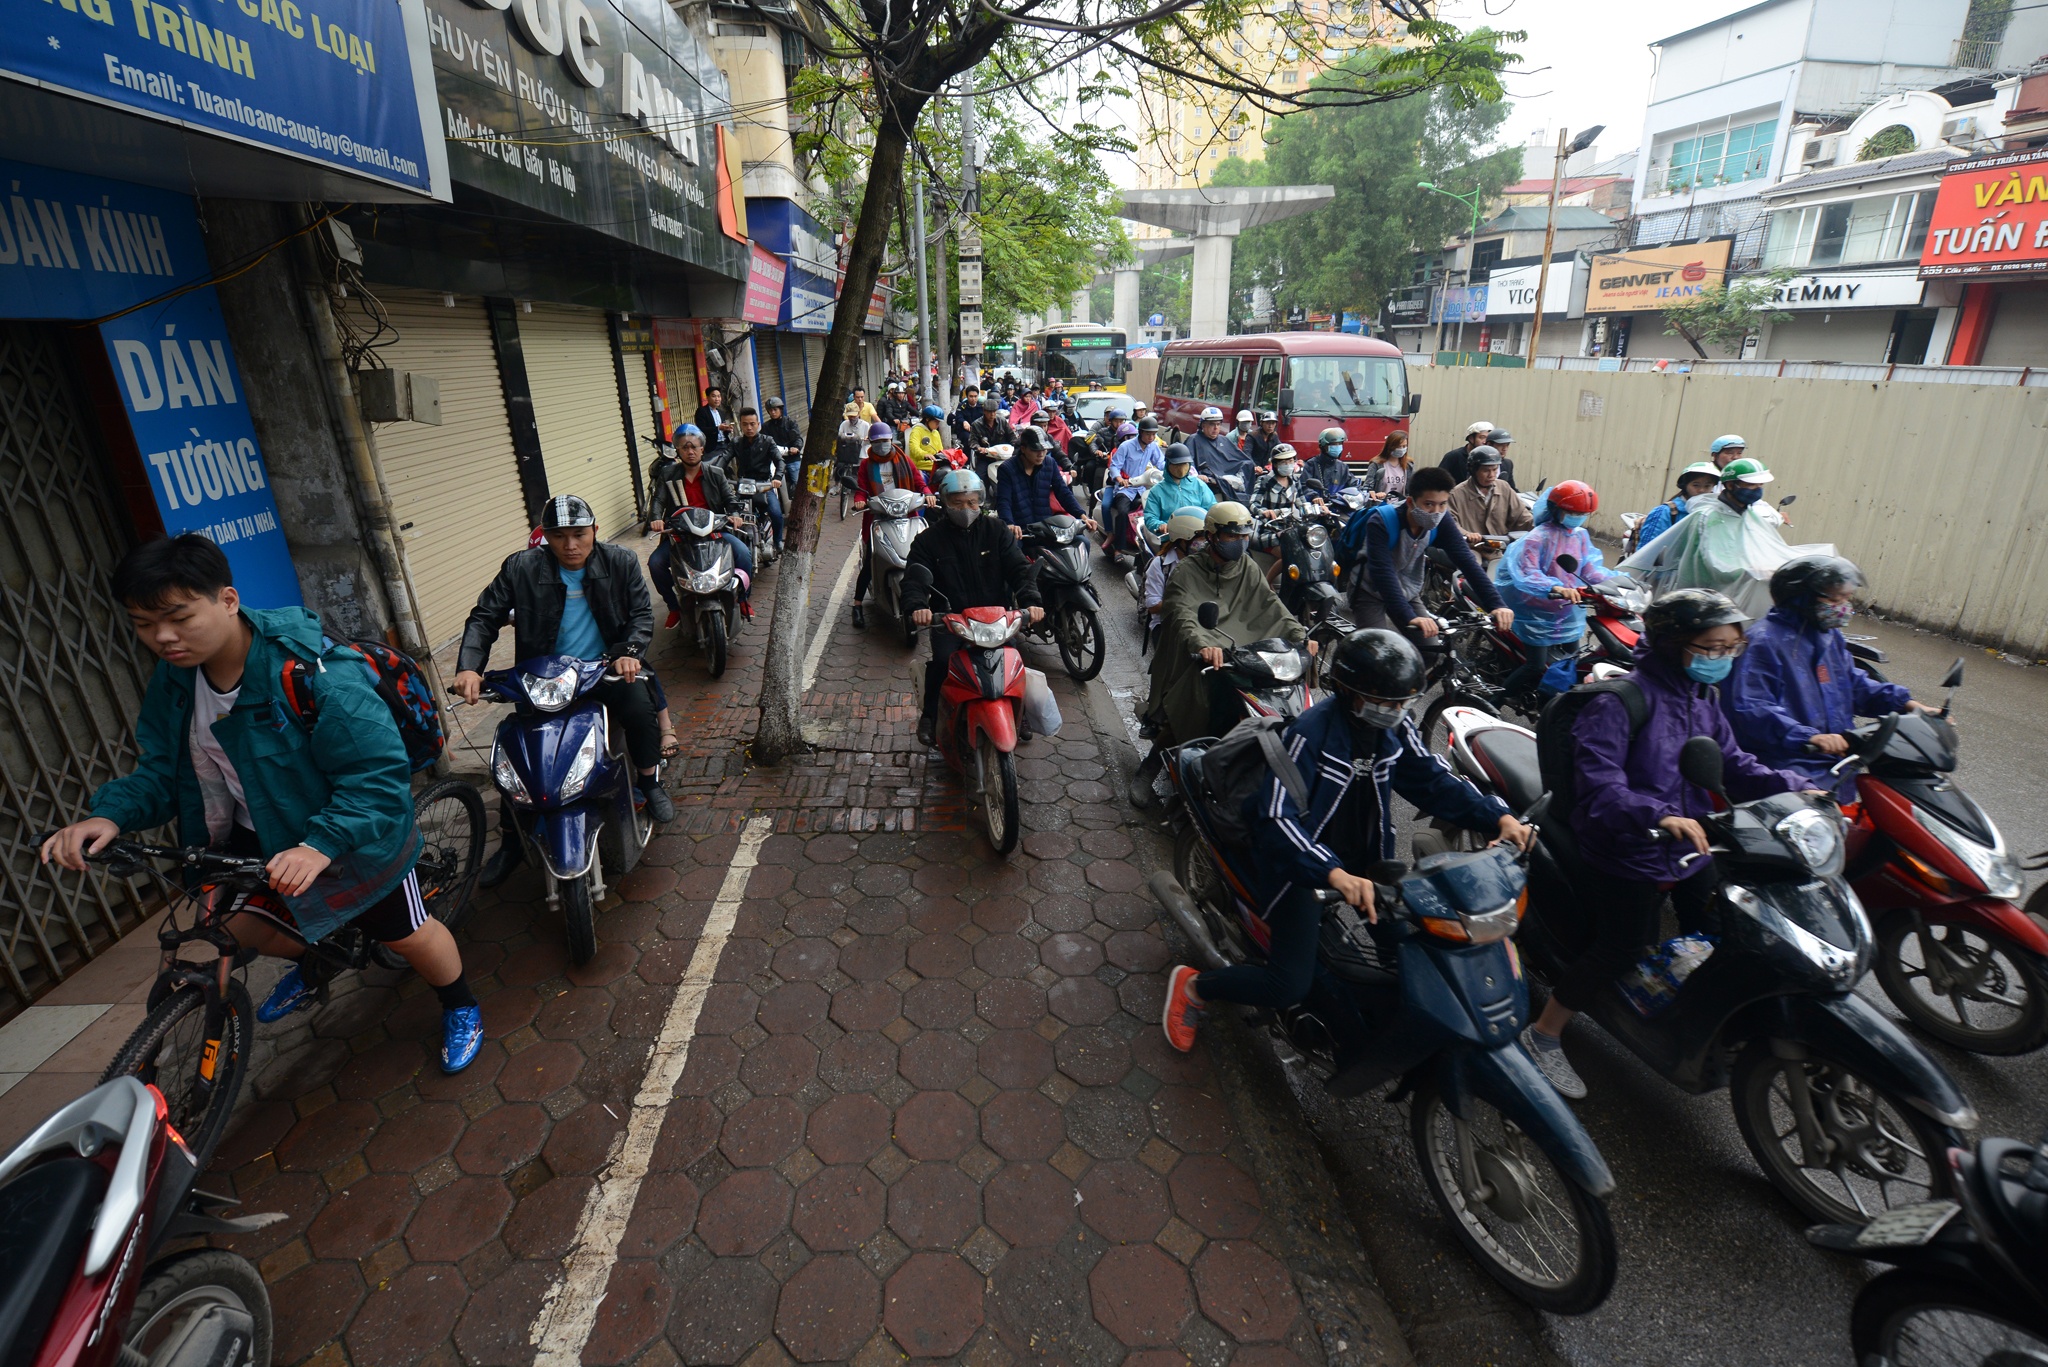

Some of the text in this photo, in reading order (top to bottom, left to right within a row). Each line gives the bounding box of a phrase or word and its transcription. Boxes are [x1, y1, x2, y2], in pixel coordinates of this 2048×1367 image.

[131, 0, 255, 80] TRÌNH
[311, 13, 376, 75] LOẠI
[104, 53, 420, 178] Email: Tuanloancaugiay@gmail.com
[426, 6, 513, 92] HUYÊN
[515, 68, 568, 125] RƯỢU
[569, 104, 595, 143] BIA
[603, 126, 636, 168] BÁNH
[636, 149, 659, 183] KẸO
[660, 164, 684, 197] NHẬP
[684, 179, 705, 208] KHẨU
[622, 52, 700, 166] ANH
[522, 145, 544, 184] Giấy
[548, 158, 562, 187] Hà
[562, 164, 577, 197] Nội
[1976, 156, 1996, 168] PHÁT
[2019, 153, 2031, 164] HẠ
[75, 195, 175, 277] KÍNH
[1933, 210, 2026, 255] TUẤN
[1599, 270, 1674, 290] GENVIET
[1655, 284, 1703, 299] JEANS
[1771, 283, 1861, 303] REMMY
[1921, 265, 1943, 275] 359
[113, 323, 238, 413] DÁN
[148, 427, 266, 511] TƯỜNG
[213, 517, 240, 545] DÁN
[236, 515, 256, 541] TẠI
[253, 506, 277, 534] NHÀ
